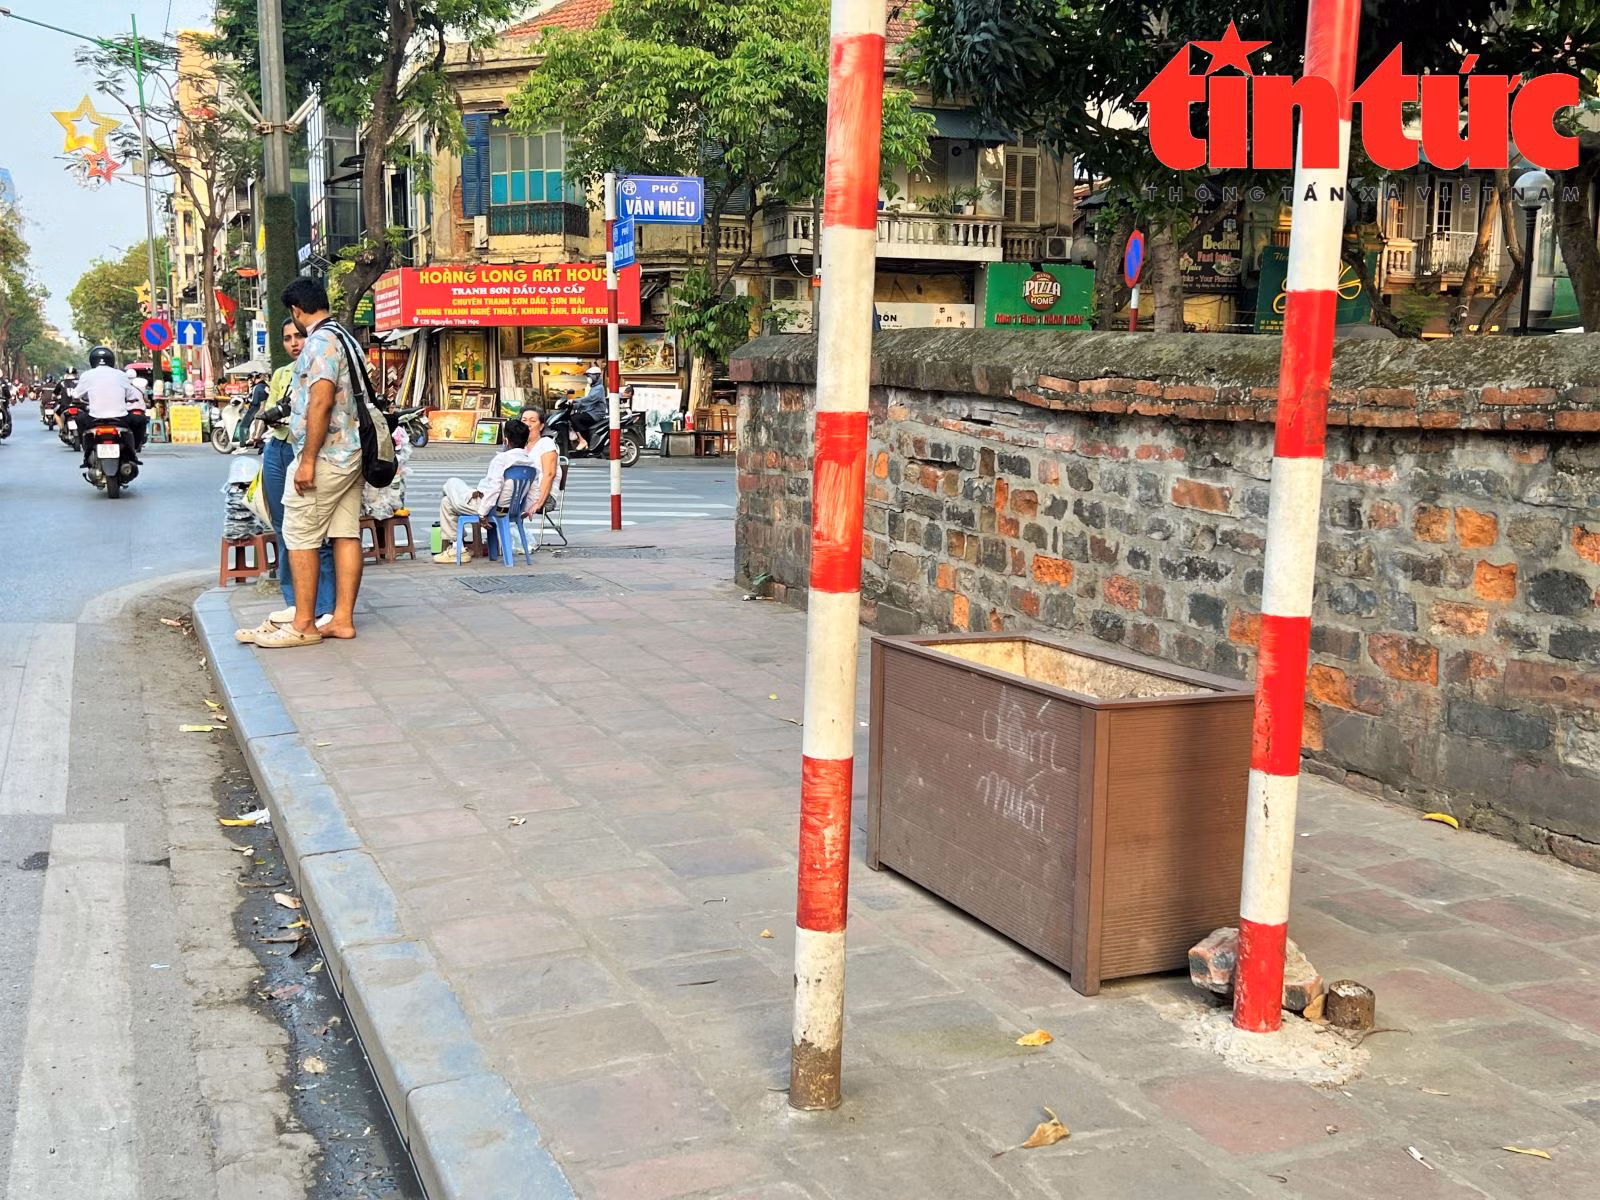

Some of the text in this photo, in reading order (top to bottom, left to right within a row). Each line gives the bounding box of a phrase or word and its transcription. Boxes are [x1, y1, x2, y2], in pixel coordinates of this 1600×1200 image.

[651, 182, 679, 194] PHỐ
[625, 195, 695, 217] VĂN MIẾU
[419, 267, 477, 284] HOÀNG
[481, 269, 527, 284] LONG
[532, 268, 562, 282] ART
[451, 287, 487, 296] TRANH
[489, 286, 511, 295] SƠN
[538, 286, 561, 295] CAO
[562, 283, 586, 295] CẤP
[1023, 279, 1061, 297] PIZZA
[451, 297, 483, 306] CHUYÊN
[484, 297, 510, 305] TRANH
[1030, 297, 1055, 305] HOME
[415, 307, 442, 316] KHUNG
[443, 307, 469, 316] TRANH
[470, 306, 492, 317] NGHỆ
[520, 306, 548, 316] KHUNG
